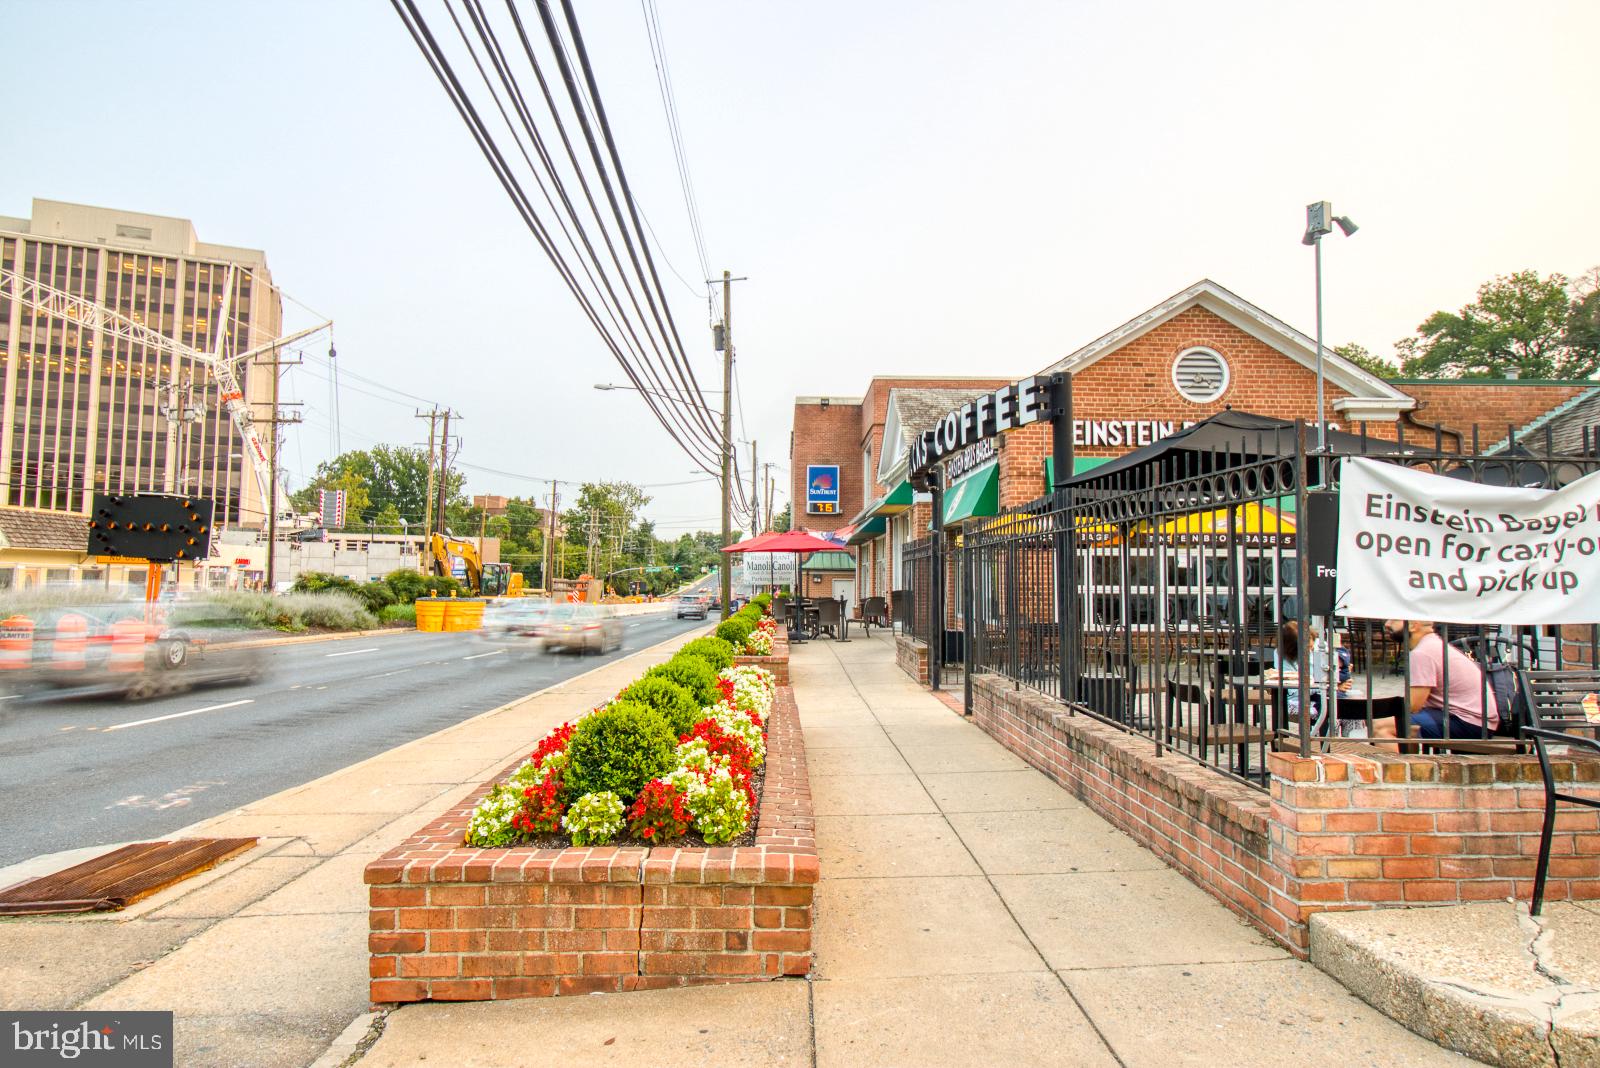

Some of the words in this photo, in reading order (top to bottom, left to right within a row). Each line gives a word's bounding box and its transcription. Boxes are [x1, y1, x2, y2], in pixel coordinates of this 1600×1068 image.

[934, 376, 1039, 456] COFFEE
[1073, 421, 1174, 446] EINSTEIN
[1366, 493, 1494, 534] Einstein
[1498, 503, 1587, 535] Bagel
[1245, 534, 1291, 545] BAGES
[1355, 531, 1431, 558] open
[1441, 533, 1490, 563] for
[1497, 536, 1600, 564] carry-o
[746, 560, 770, 571] Manoli
[773, 560, 795, 571] Canoli
[1408, 567, 1468, 592] and
[1476, 566, 1538, 597] pick
[1542, 570, 1578, 595] up
